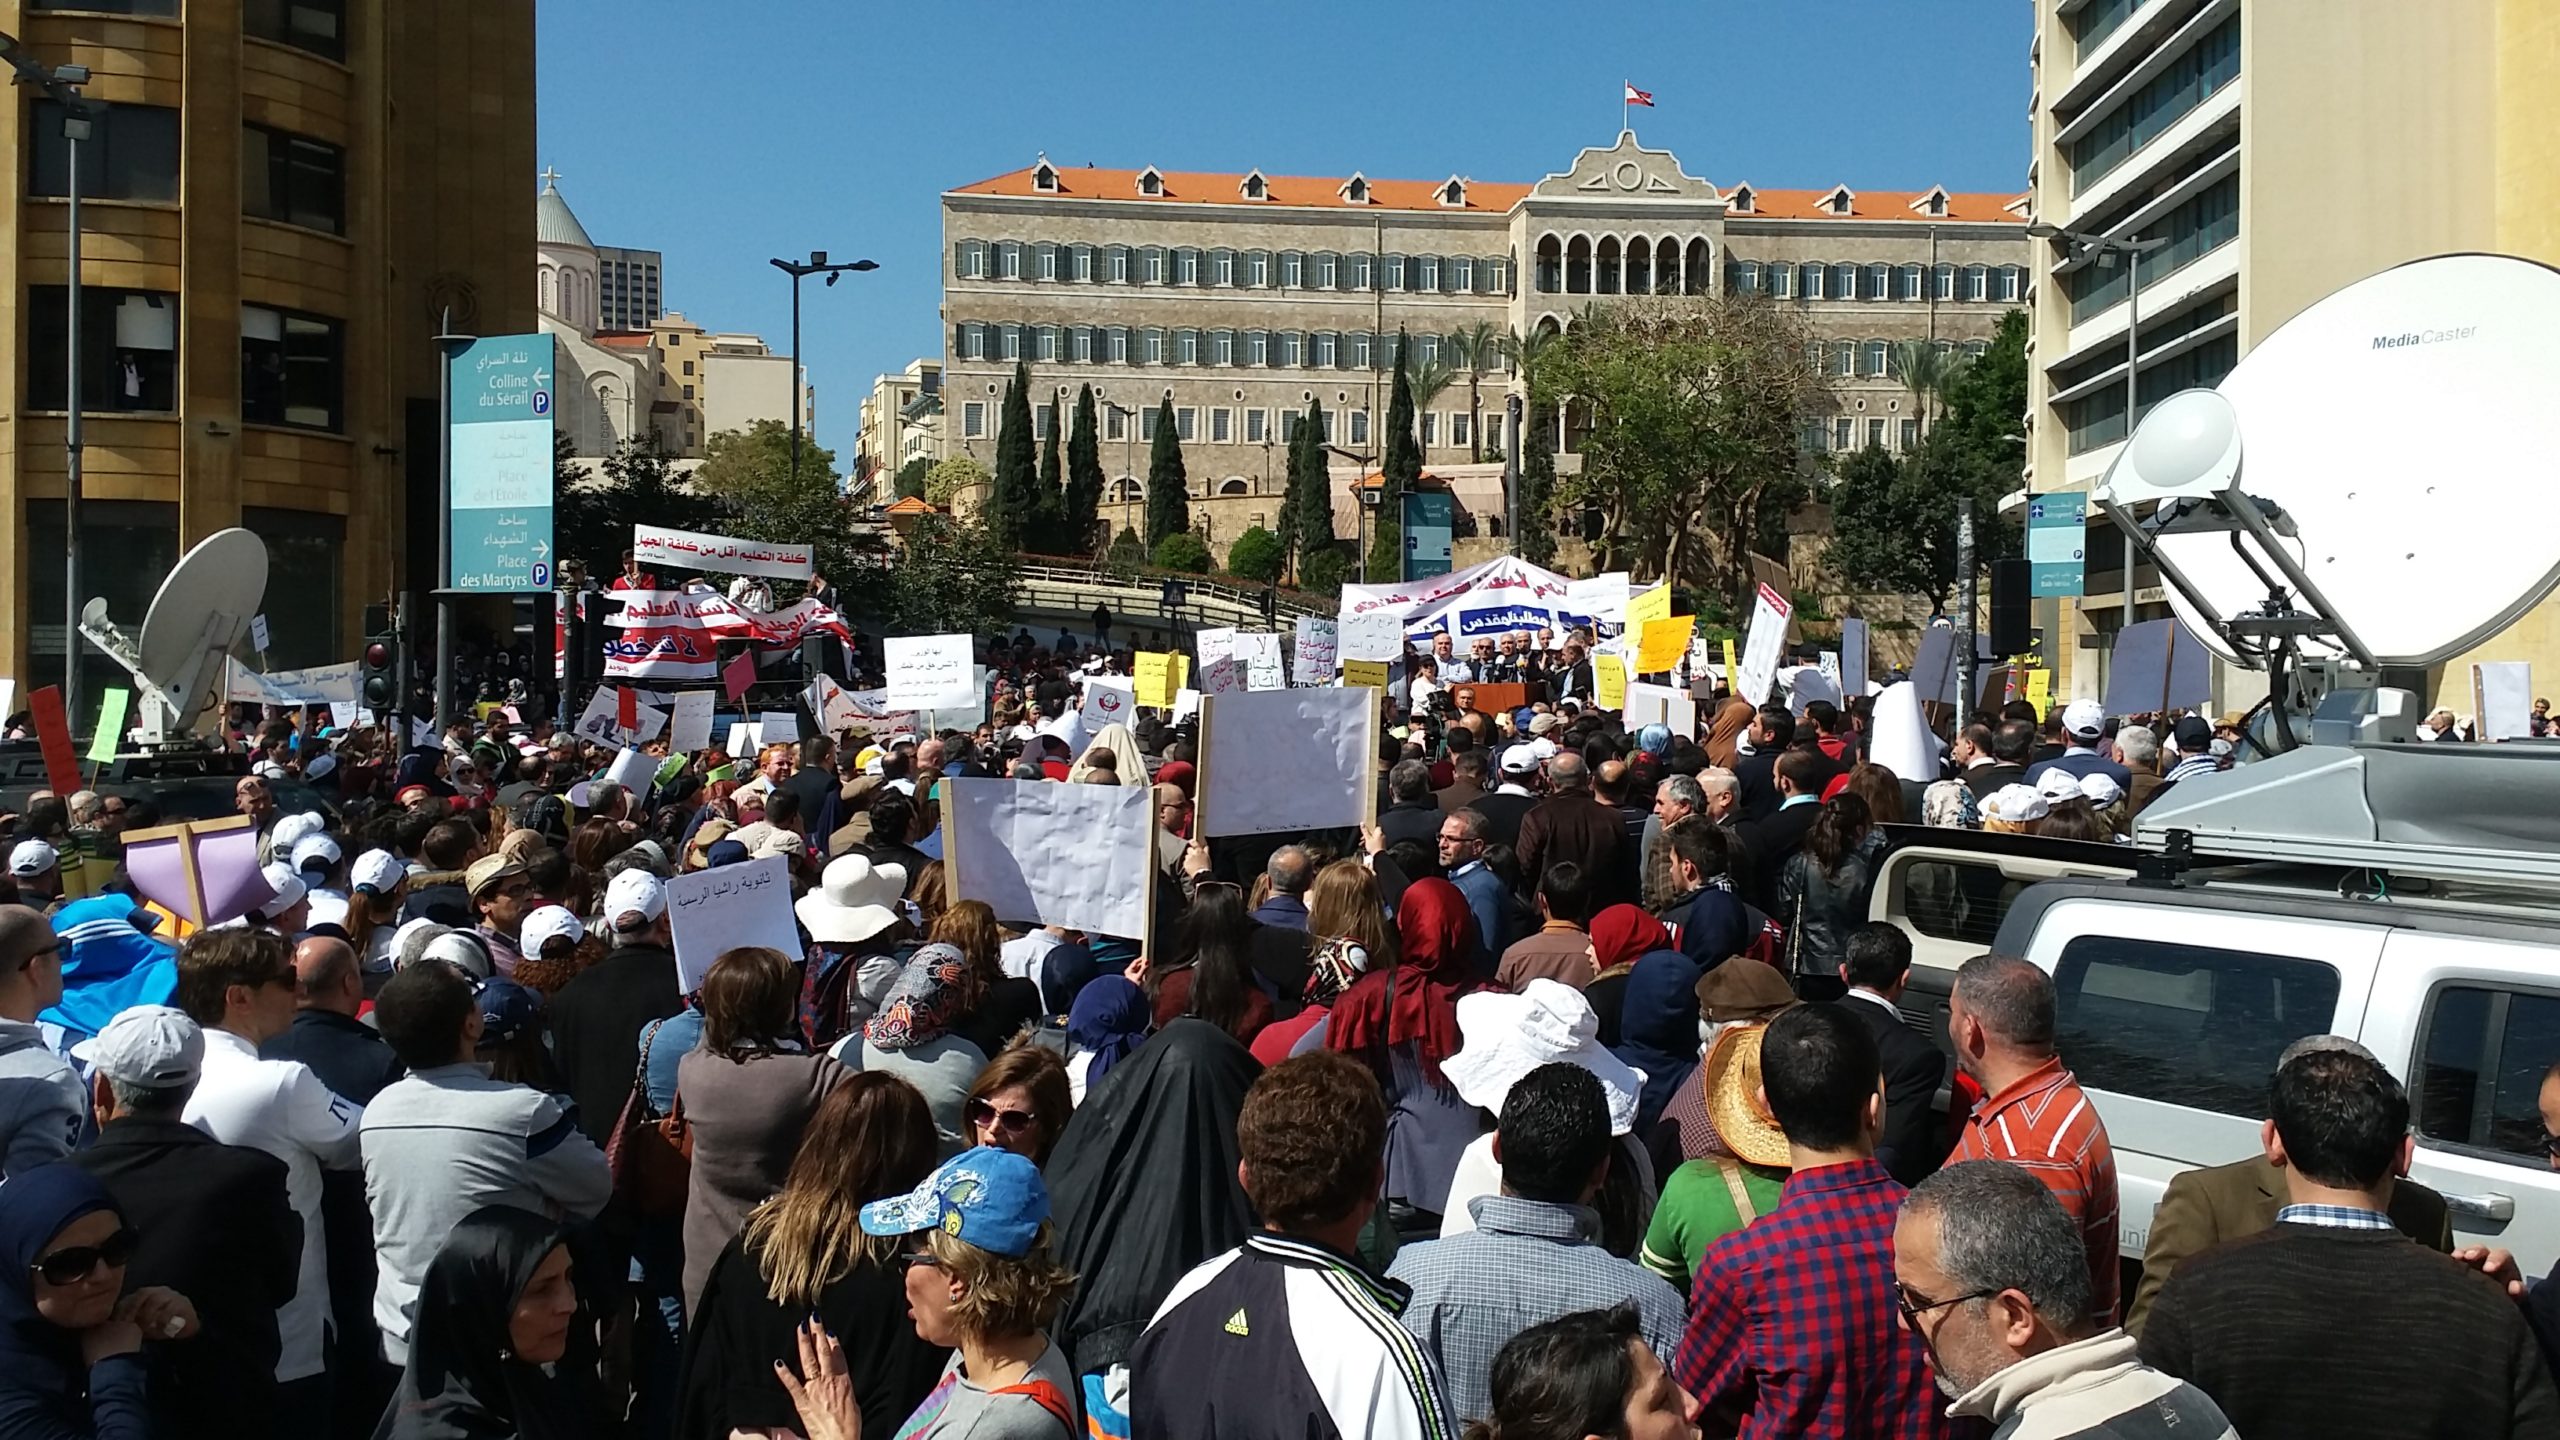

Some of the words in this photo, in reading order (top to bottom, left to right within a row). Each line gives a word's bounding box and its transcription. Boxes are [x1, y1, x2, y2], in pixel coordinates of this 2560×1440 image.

[2372, 326, 2477, 350] MediaCaster
[476, 352, 509, 373] السراي
[489, 374, 529, 389] Colline
[479, 392, 495, 407] du
[497, 389, 529, 406] Sérail
[498, 513, 528, 526] ساحة
[483, 531, 528, 548] الشهداء
[635, 534, 665, 550] الجهل
[667, 537, 698, 553] كلفة
[700, 544, 716, 556] من
[718, 545, 737, 559] أقل
[739, 551, 774, 562] التعليم
[776, 552, 807, 564] كلفة
[497, 554, 528, 568] Place
[460, 573, 480, 587] des
[482, 573, 528, 590] Martyrs
[627, 600, 681, 621] التعليم
[679, 634, 700, 658] لا
[1256, 636, 1267, 655] لا
[742, 871, 771, 890] ثانوية
[678, 886, 710, 910] الرسمية
[713, 881, 740, 898] راشيا
[1225, 1323, 1249, 1336] adidas
